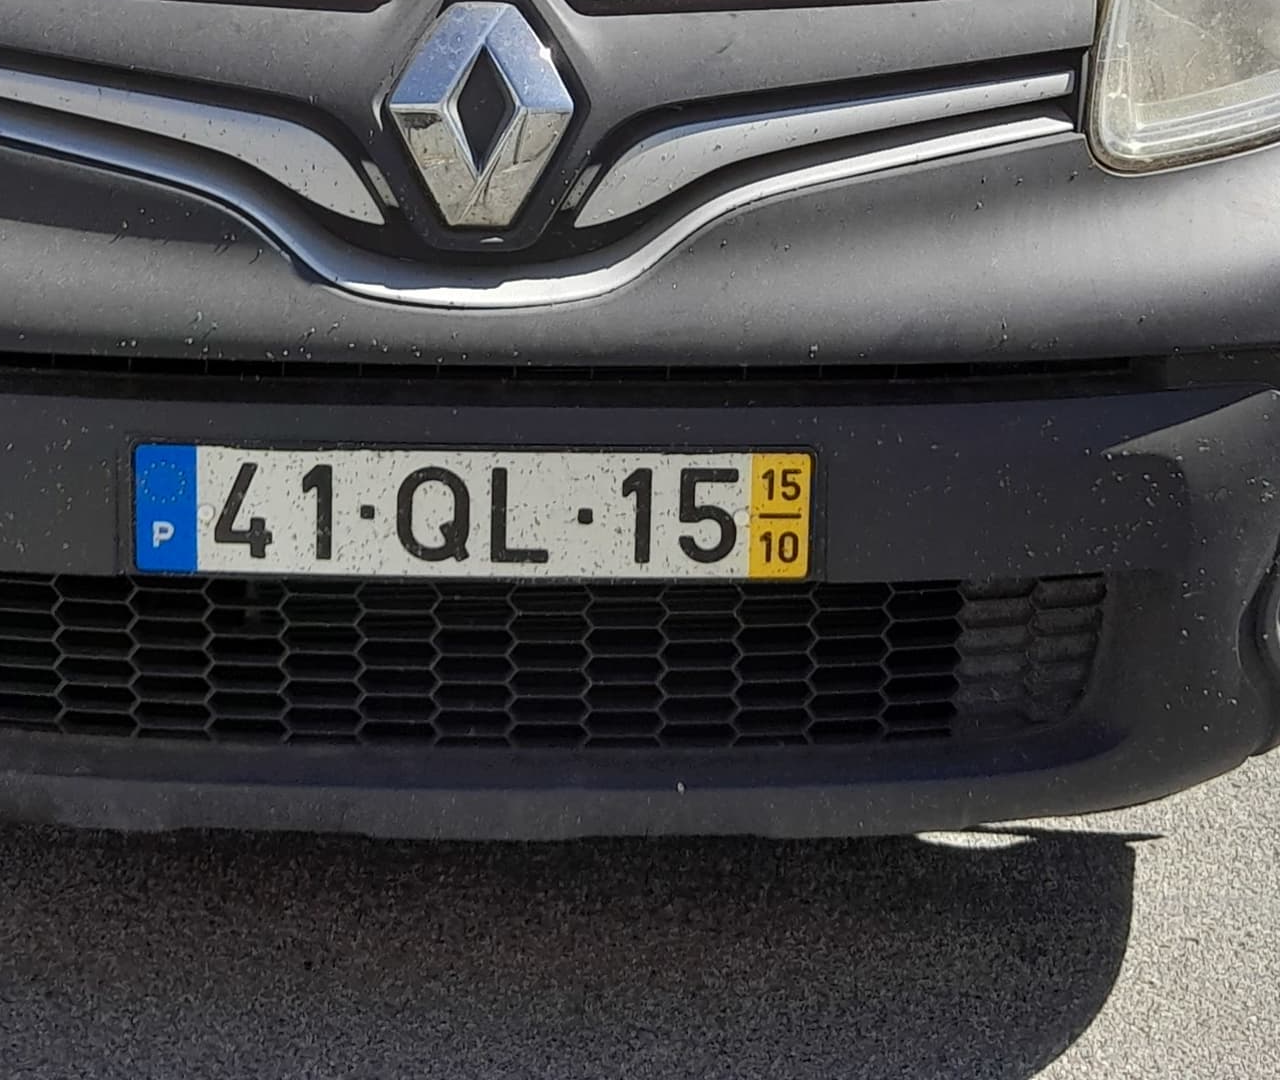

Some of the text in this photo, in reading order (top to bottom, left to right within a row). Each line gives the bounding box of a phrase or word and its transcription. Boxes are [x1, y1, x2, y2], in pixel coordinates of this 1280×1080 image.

[152, 521, 174, 548] P
[761, 469, 802, 501] 15
[760, 531, 799, 563] 10
